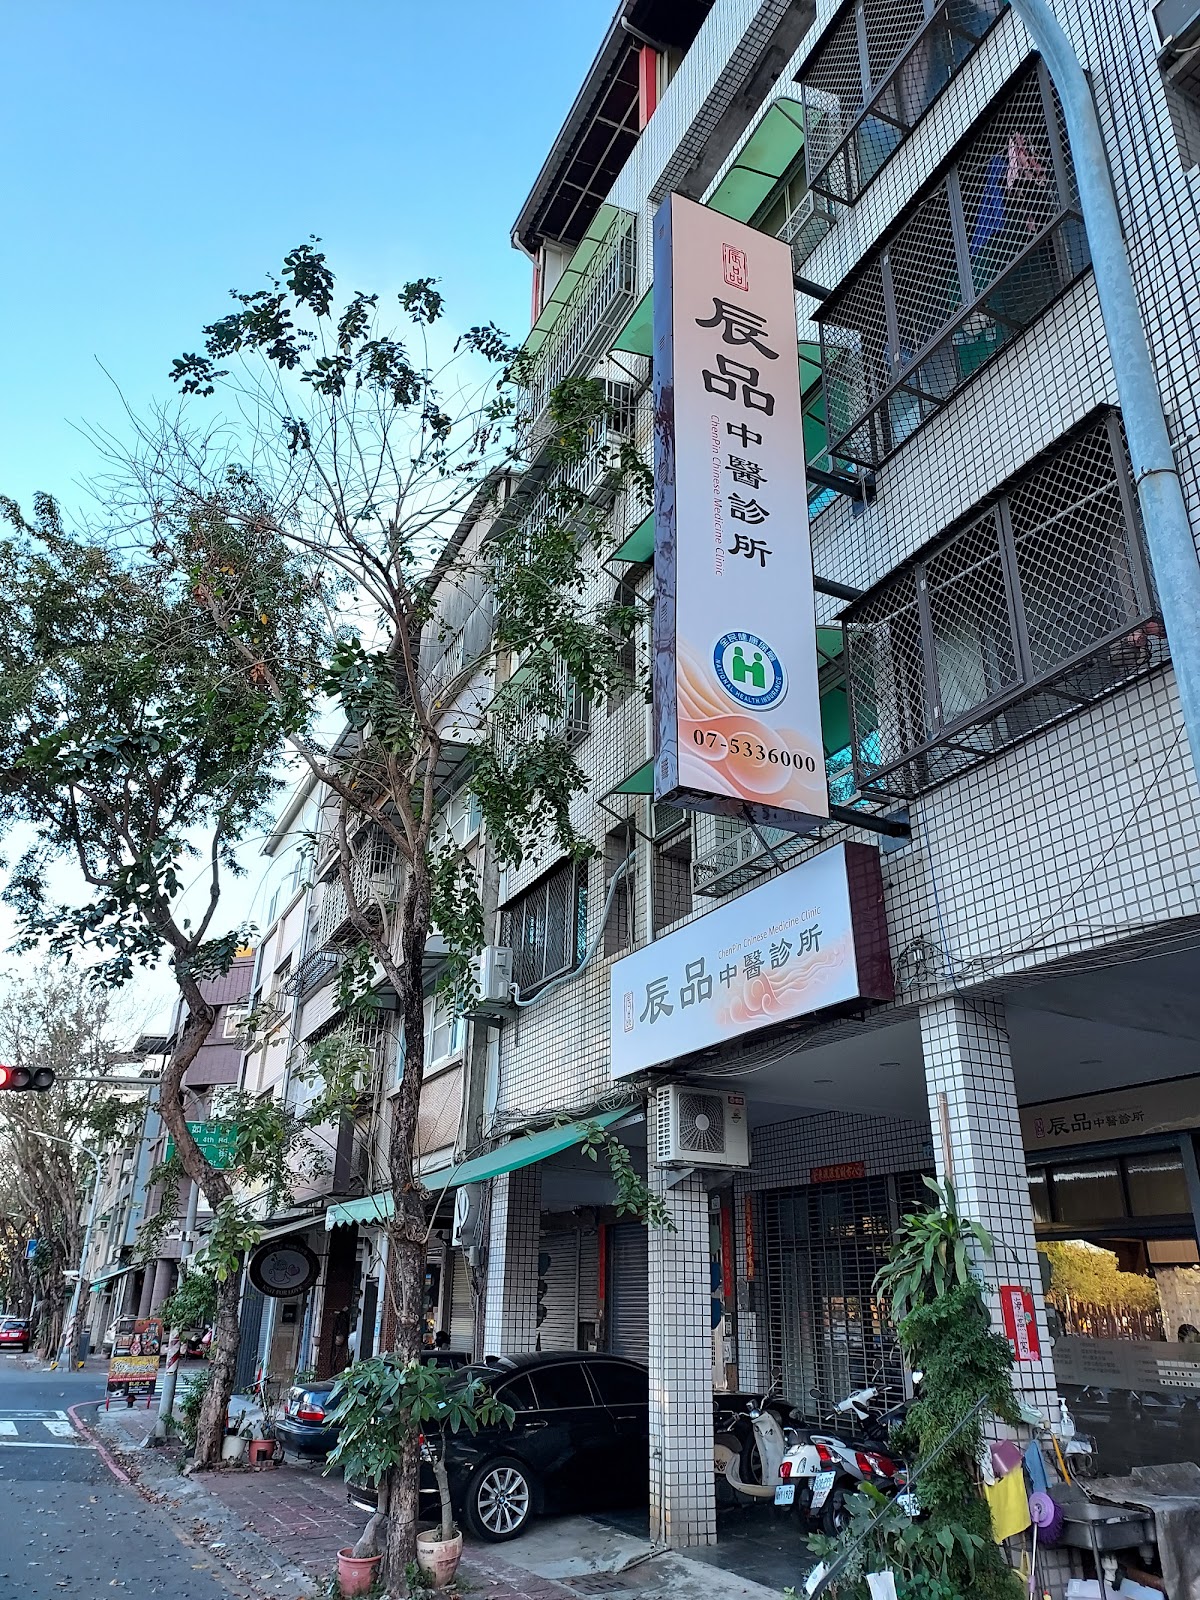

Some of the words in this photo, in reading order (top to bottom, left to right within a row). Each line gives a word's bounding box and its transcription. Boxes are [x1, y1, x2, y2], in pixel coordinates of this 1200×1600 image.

[710, 414, 721, 454] ChenPin
[711, 456, 721, 495] Chinese
[713, 498, 724, 544] Medicine
[715, 548, 725, 576] Clinic
[715, 658, 734, 693] NATIONAL
[735, 691, 761, 704] HEALTH
[760, 676, 782, 704] INSURANCE
[693, 729, 816, 773] 07-5336000
[718, 942, 742, 959] ChenPin
[743, 931, 768, 948] Chinese
[768, 916, 799, 936] Medicine
[801, 906, 821, 922] Clinic
